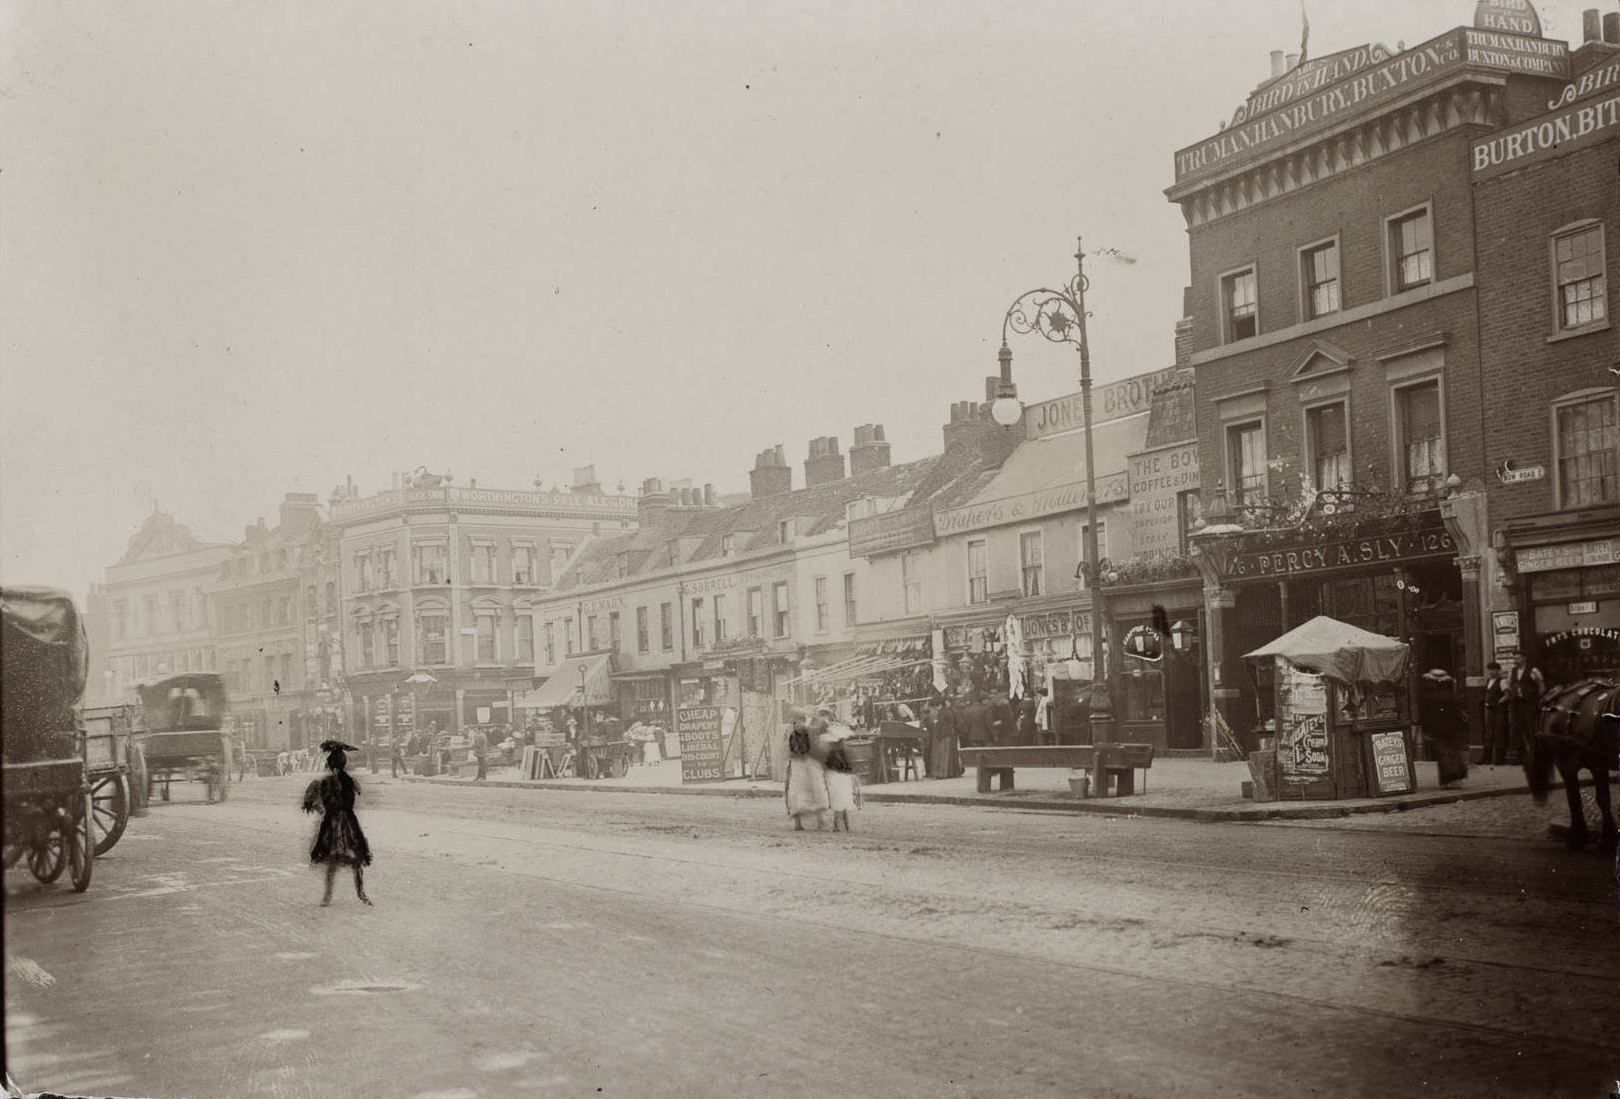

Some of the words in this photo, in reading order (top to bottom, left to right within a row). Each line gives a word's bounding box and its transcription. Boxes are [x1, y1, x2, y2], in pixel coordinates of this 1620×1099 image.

[1249, 82, 1293, 117] BIRD
[1037, 401, 1083, 430] JONE
[1134, 457, 1160, 476] THE
[1133, 476, 1171, 493] COFFEE
[1154, 496, 1175, 511] OUR
[1259, 547, 1327, 574] PERCY
[1360, 536, 1403, 562] SLY
[1421, 533, 1451, 552] 126
[680, 709, 717, 721] CHEAP
[685, 731, 719, 742] BOOTS
[1378, 754, 1404, 766] GINGER
[684, 768, 720, 780] CLUBS
[1382, 766, 1405, 777] BEER
